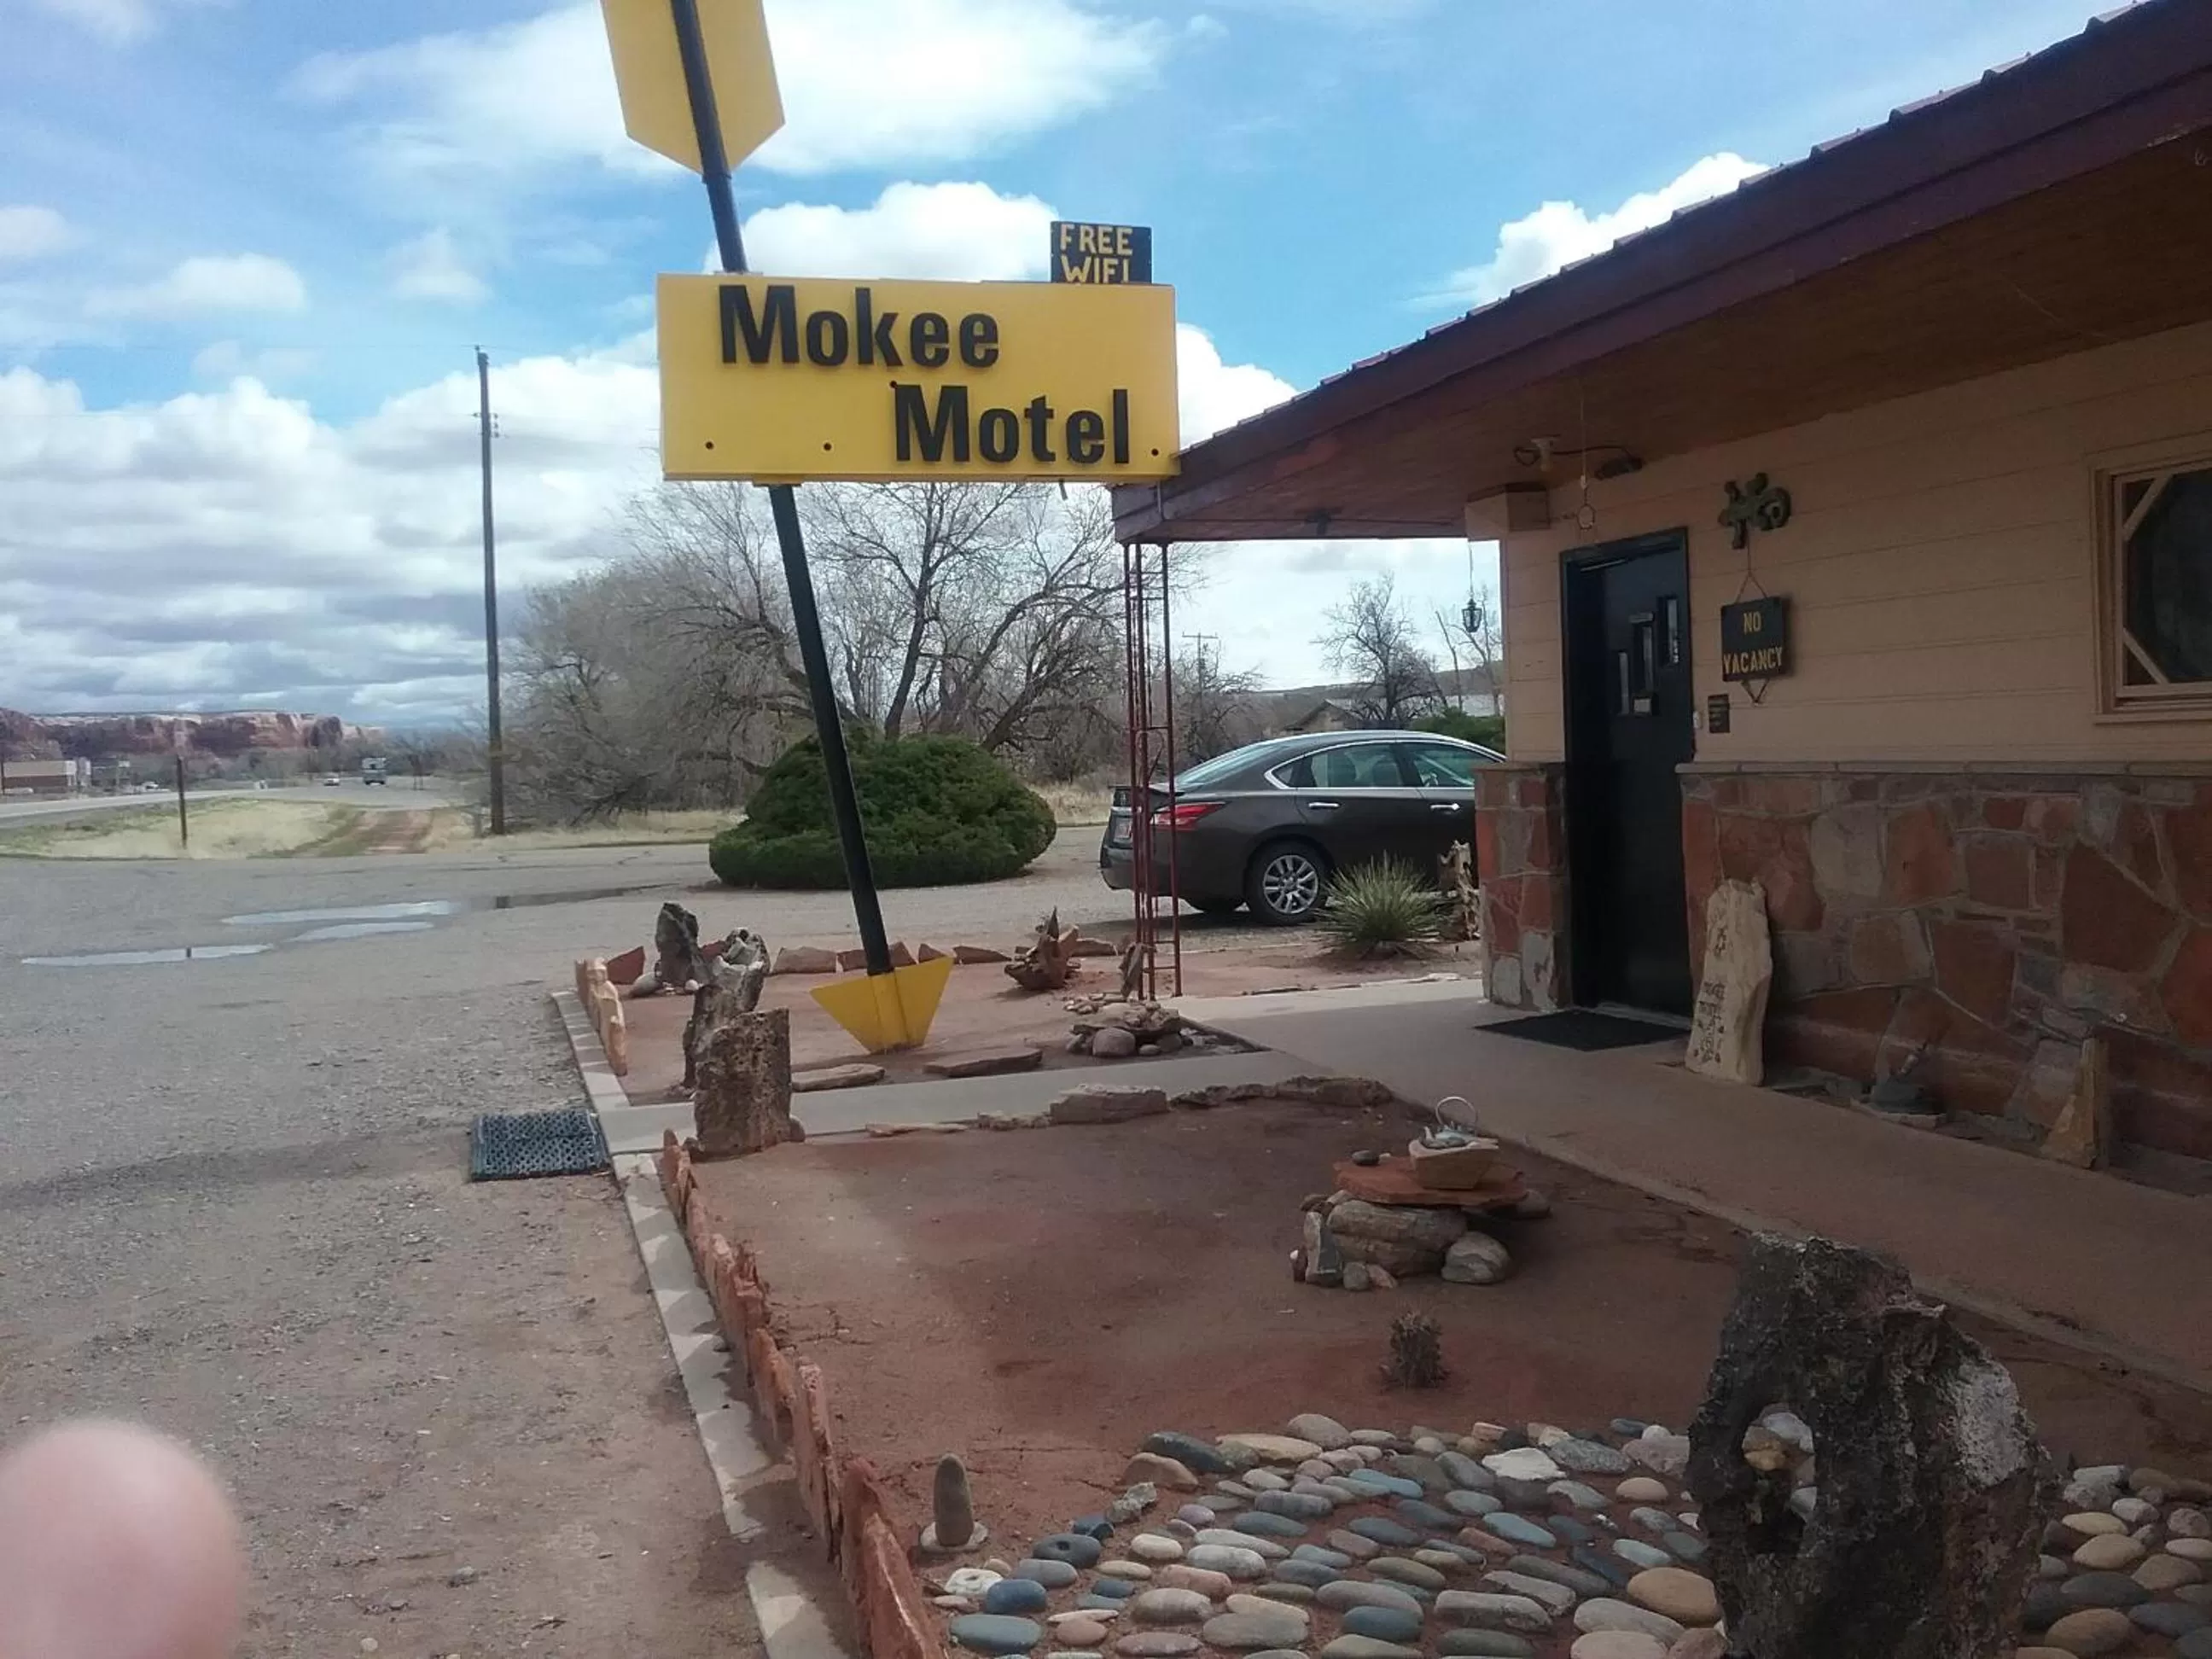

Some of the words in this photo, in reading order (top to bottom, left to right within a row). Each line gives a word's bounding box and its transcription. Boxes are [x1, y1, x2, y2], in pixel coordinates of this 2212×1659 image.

[1060, 224, 1132, 255] FREE
[1061, 254, 1129, 283] WIFI
[719, 284, 999, 368] Mokee
[894, 384, 1130, 463] Motel
[1743, 611, 1762, 635] NO
[1723, 645, 1783, 674] VACANCY
